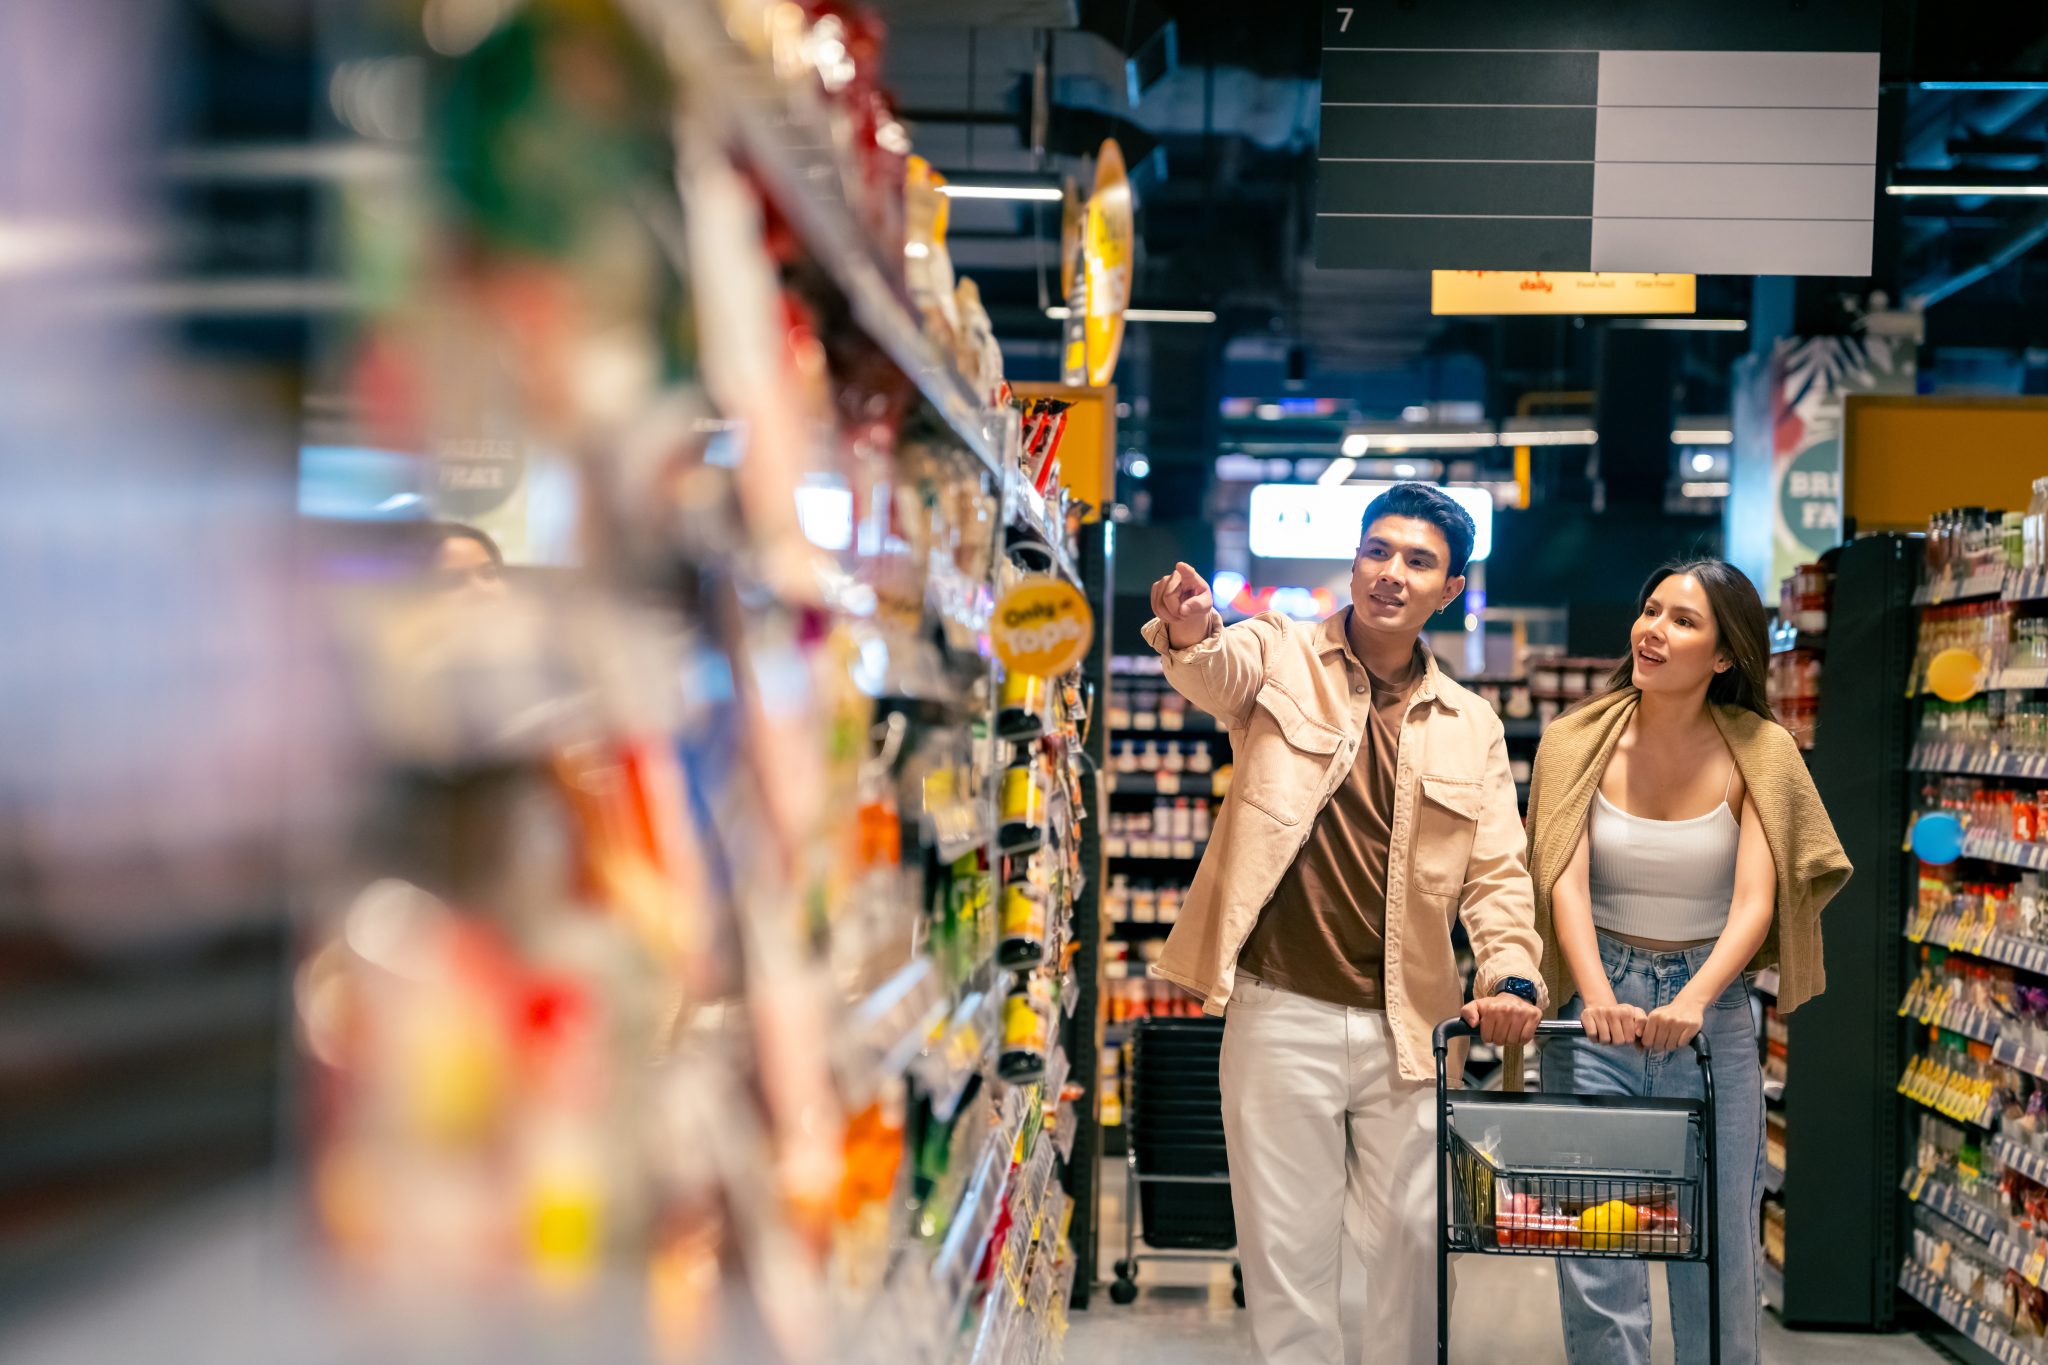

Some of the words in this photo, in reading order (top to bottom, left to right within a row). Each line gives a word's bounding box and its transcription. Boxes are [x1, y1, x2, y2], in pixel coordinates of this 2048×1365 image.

[1336, 8, 1354, 32] 7
[1519, 278, 1552, 293] daily
[1003, 601, 1056, 628] Only
